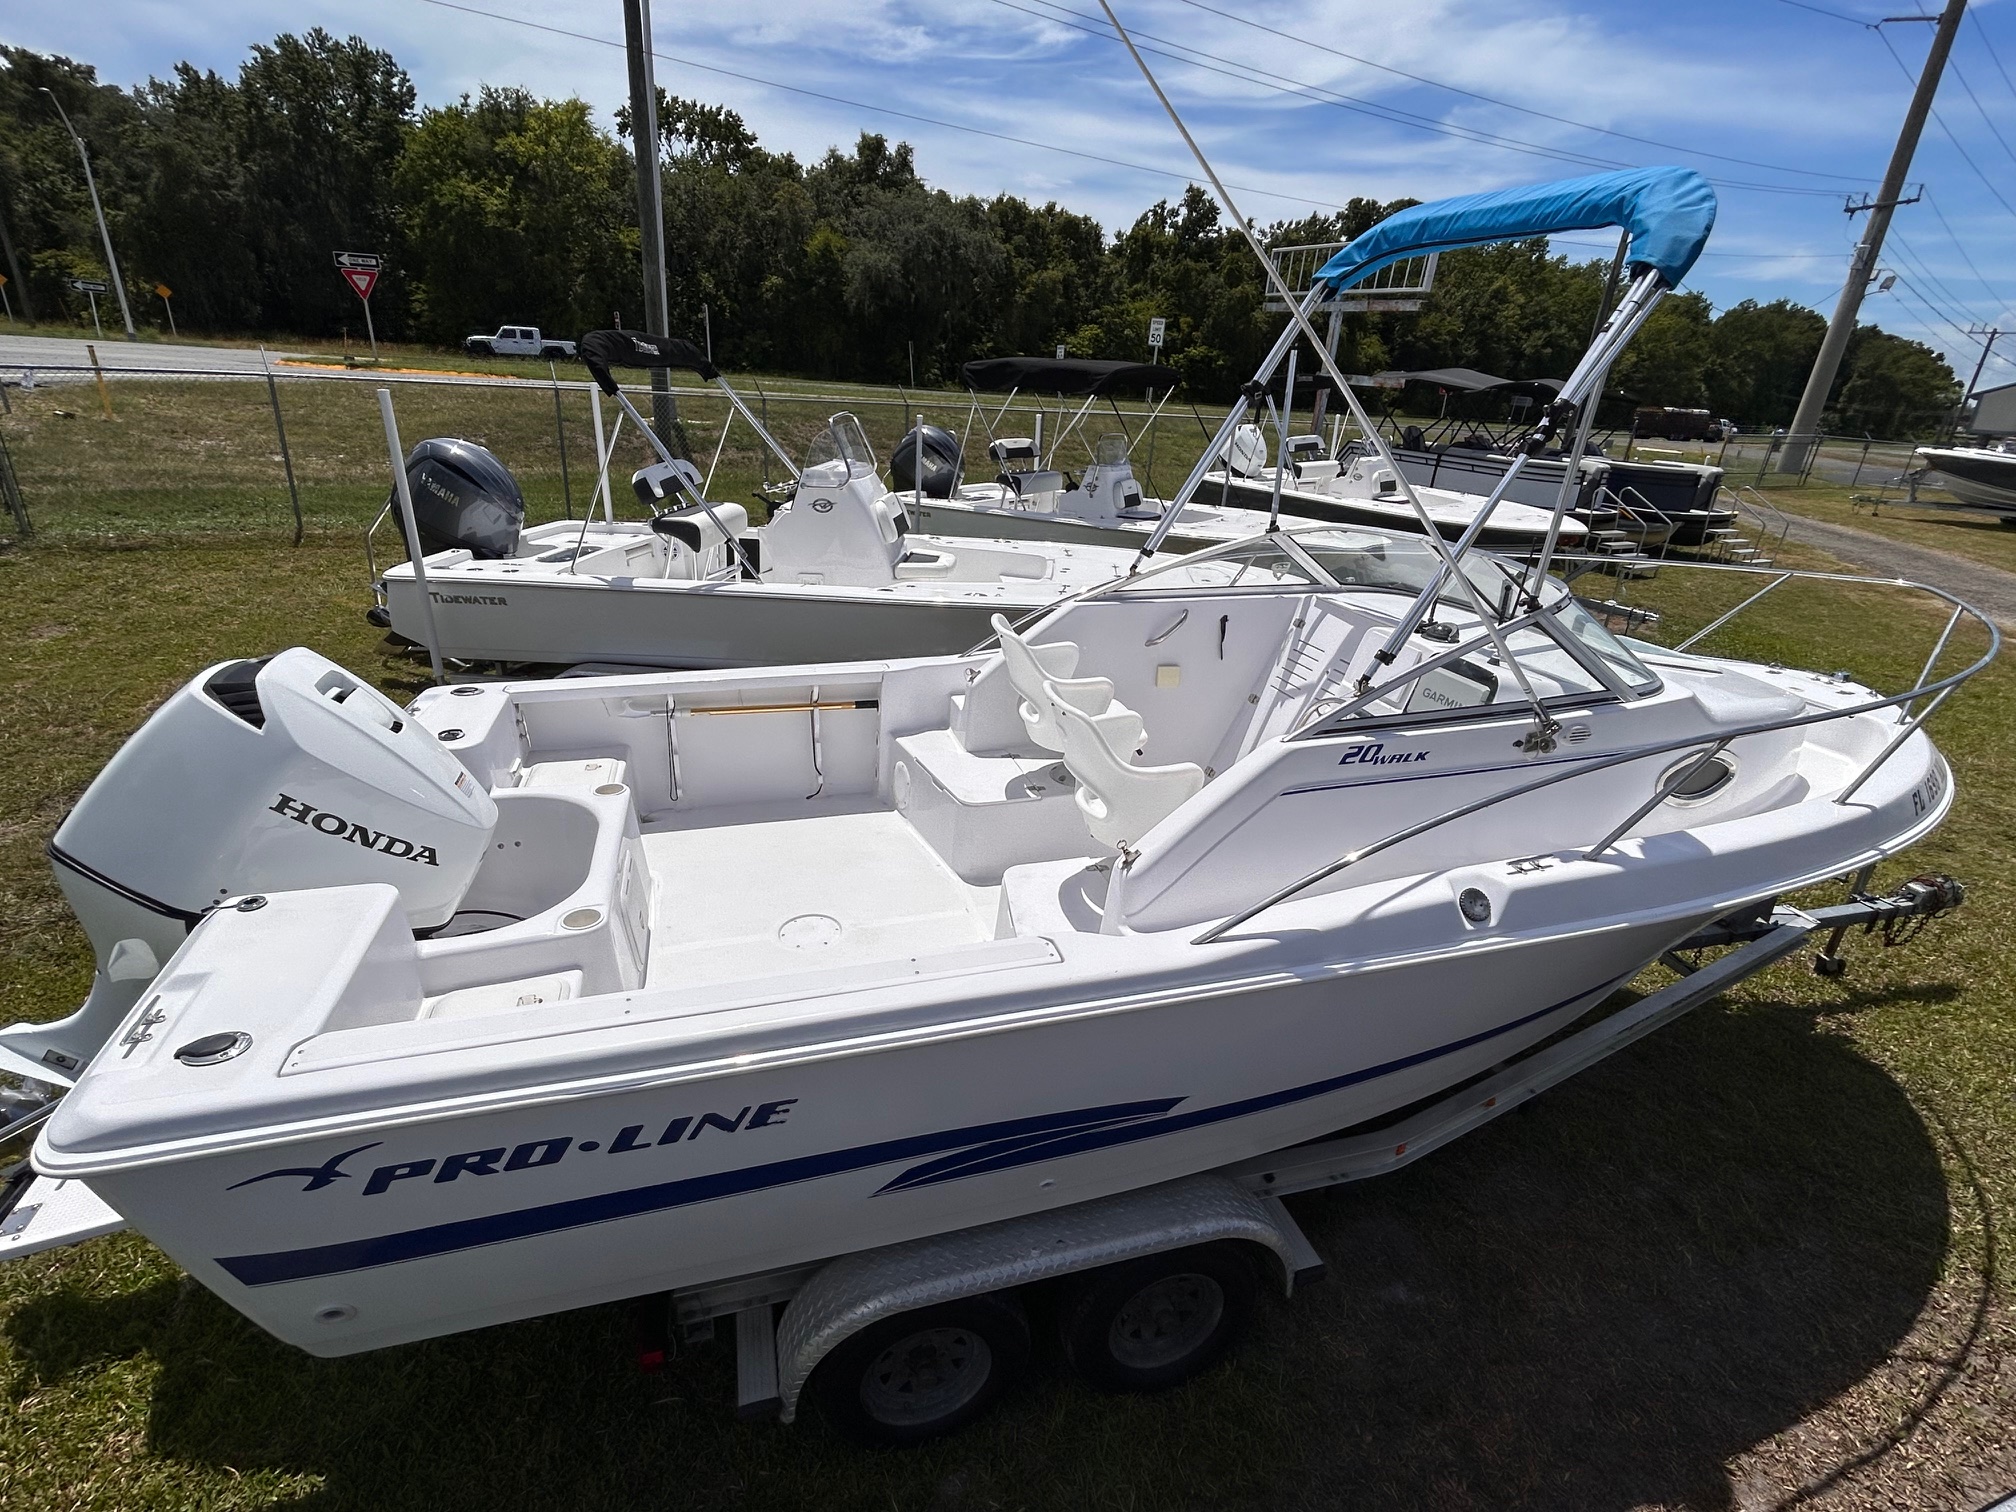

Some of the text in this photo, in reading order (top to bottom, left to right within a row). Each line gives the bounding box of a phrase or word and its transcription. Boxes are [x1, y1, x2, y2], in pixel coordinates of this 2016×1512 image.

[1150, 333, 1161, 343] 50
[428, 592, 508, 606] TIDEWATER
[1912, 789, 1926, 817] FL
[268, 793, 440, 867] HONDA
